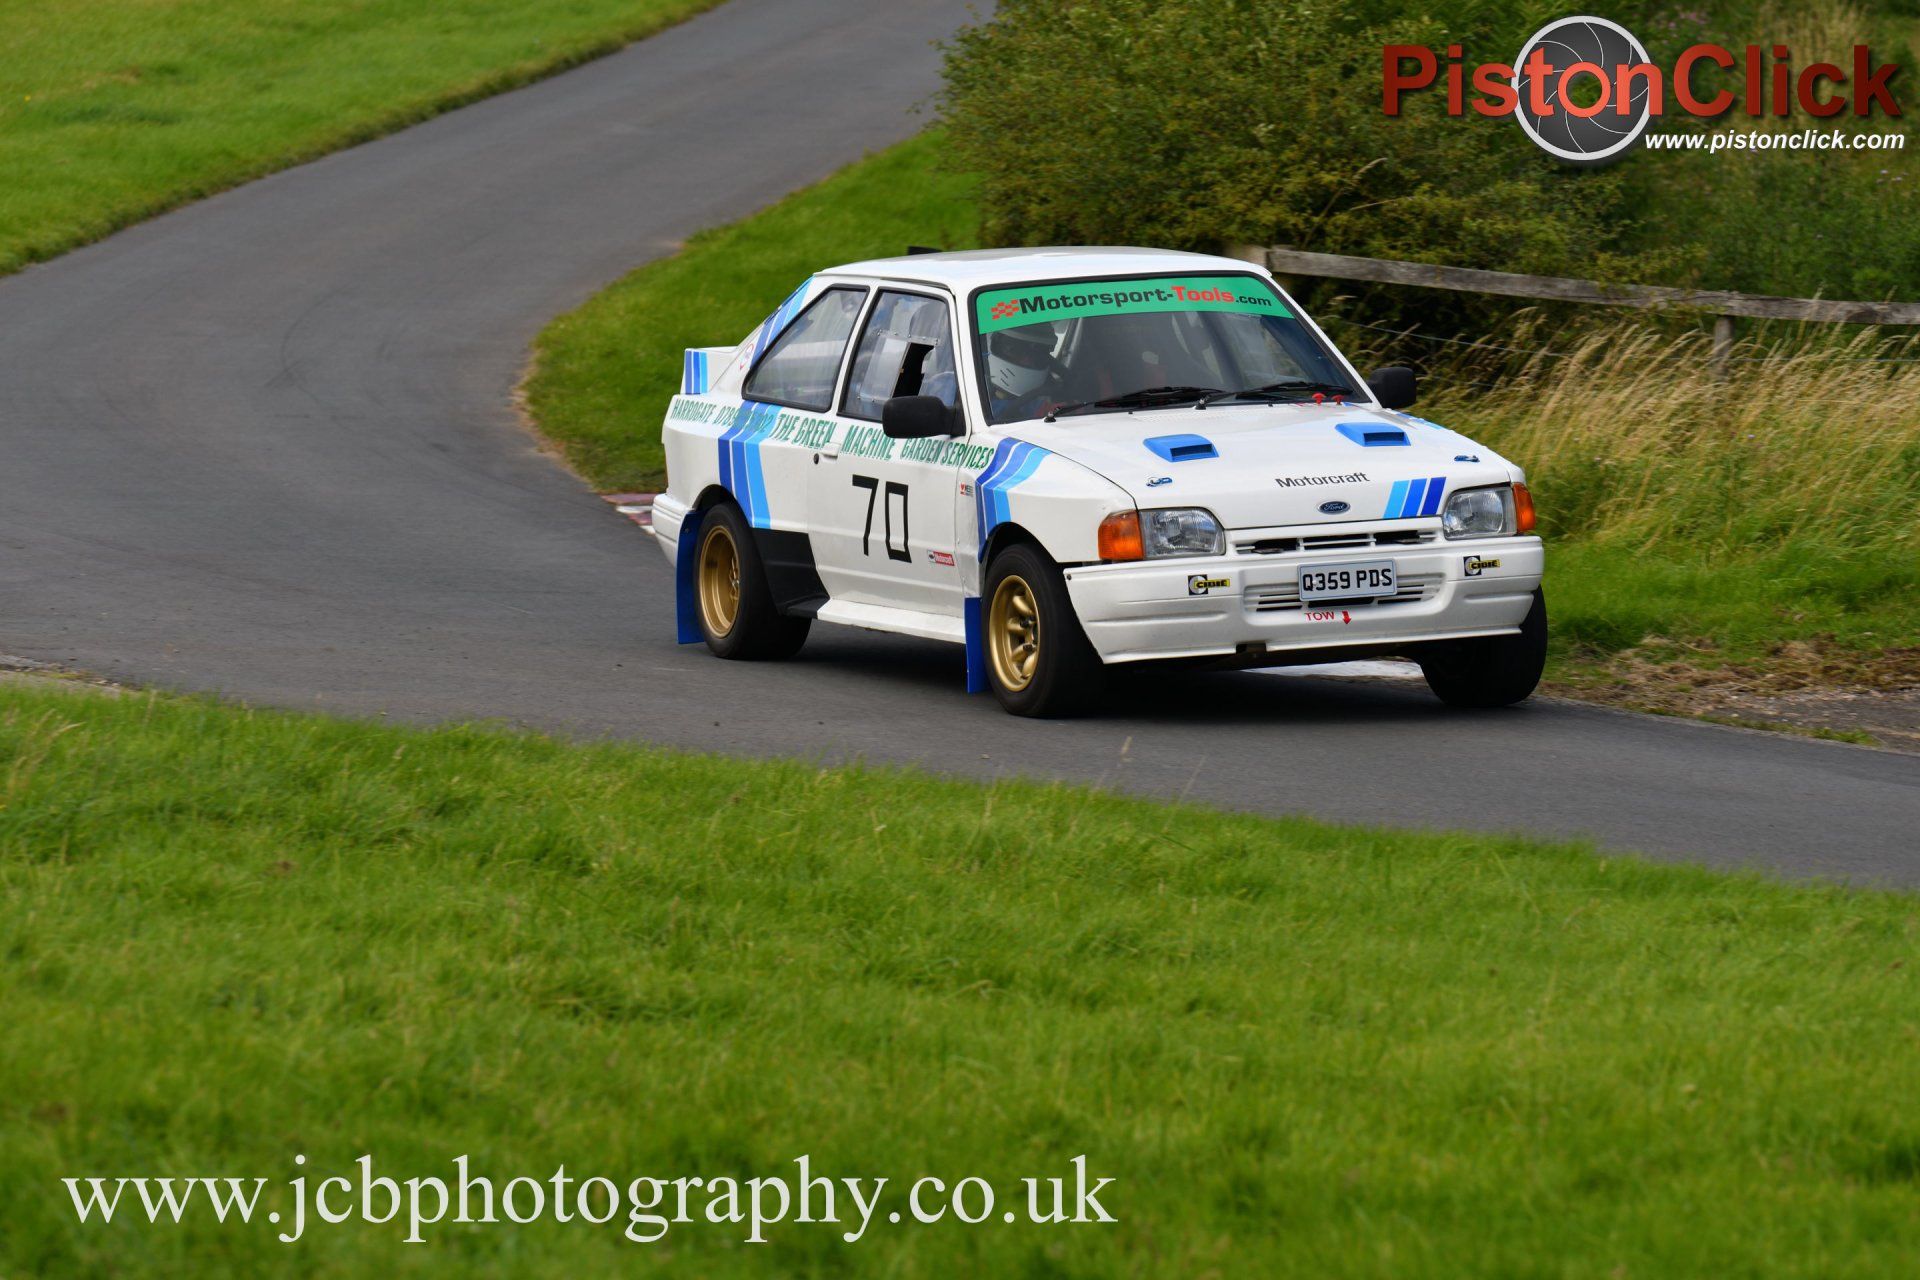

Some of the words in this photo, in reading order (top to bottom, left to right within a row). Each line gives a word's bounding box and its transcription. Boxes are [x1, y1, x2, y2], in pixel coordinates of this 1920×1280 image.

[1019, 285, 1272, 315] Motorsport-Tools.com
[671, 398, 717, 425] HARROGATE
[768, 413, 797, 442] THE
[793, 417, 838, 450] GREEN
[840, 424, 897, 462] MACHINE
[901, 437, 946, 464] GARDEN
[939, 442, 995, 470] SERVICES
[1274, 471, 1371, 488] Motorcraft
[852, 474, 912, 563] 70
[1302, 571, 1351, 591] Q359
[1356, 568, 1392, 589] PDS
[1304, 610, 1335, 621] TOW
